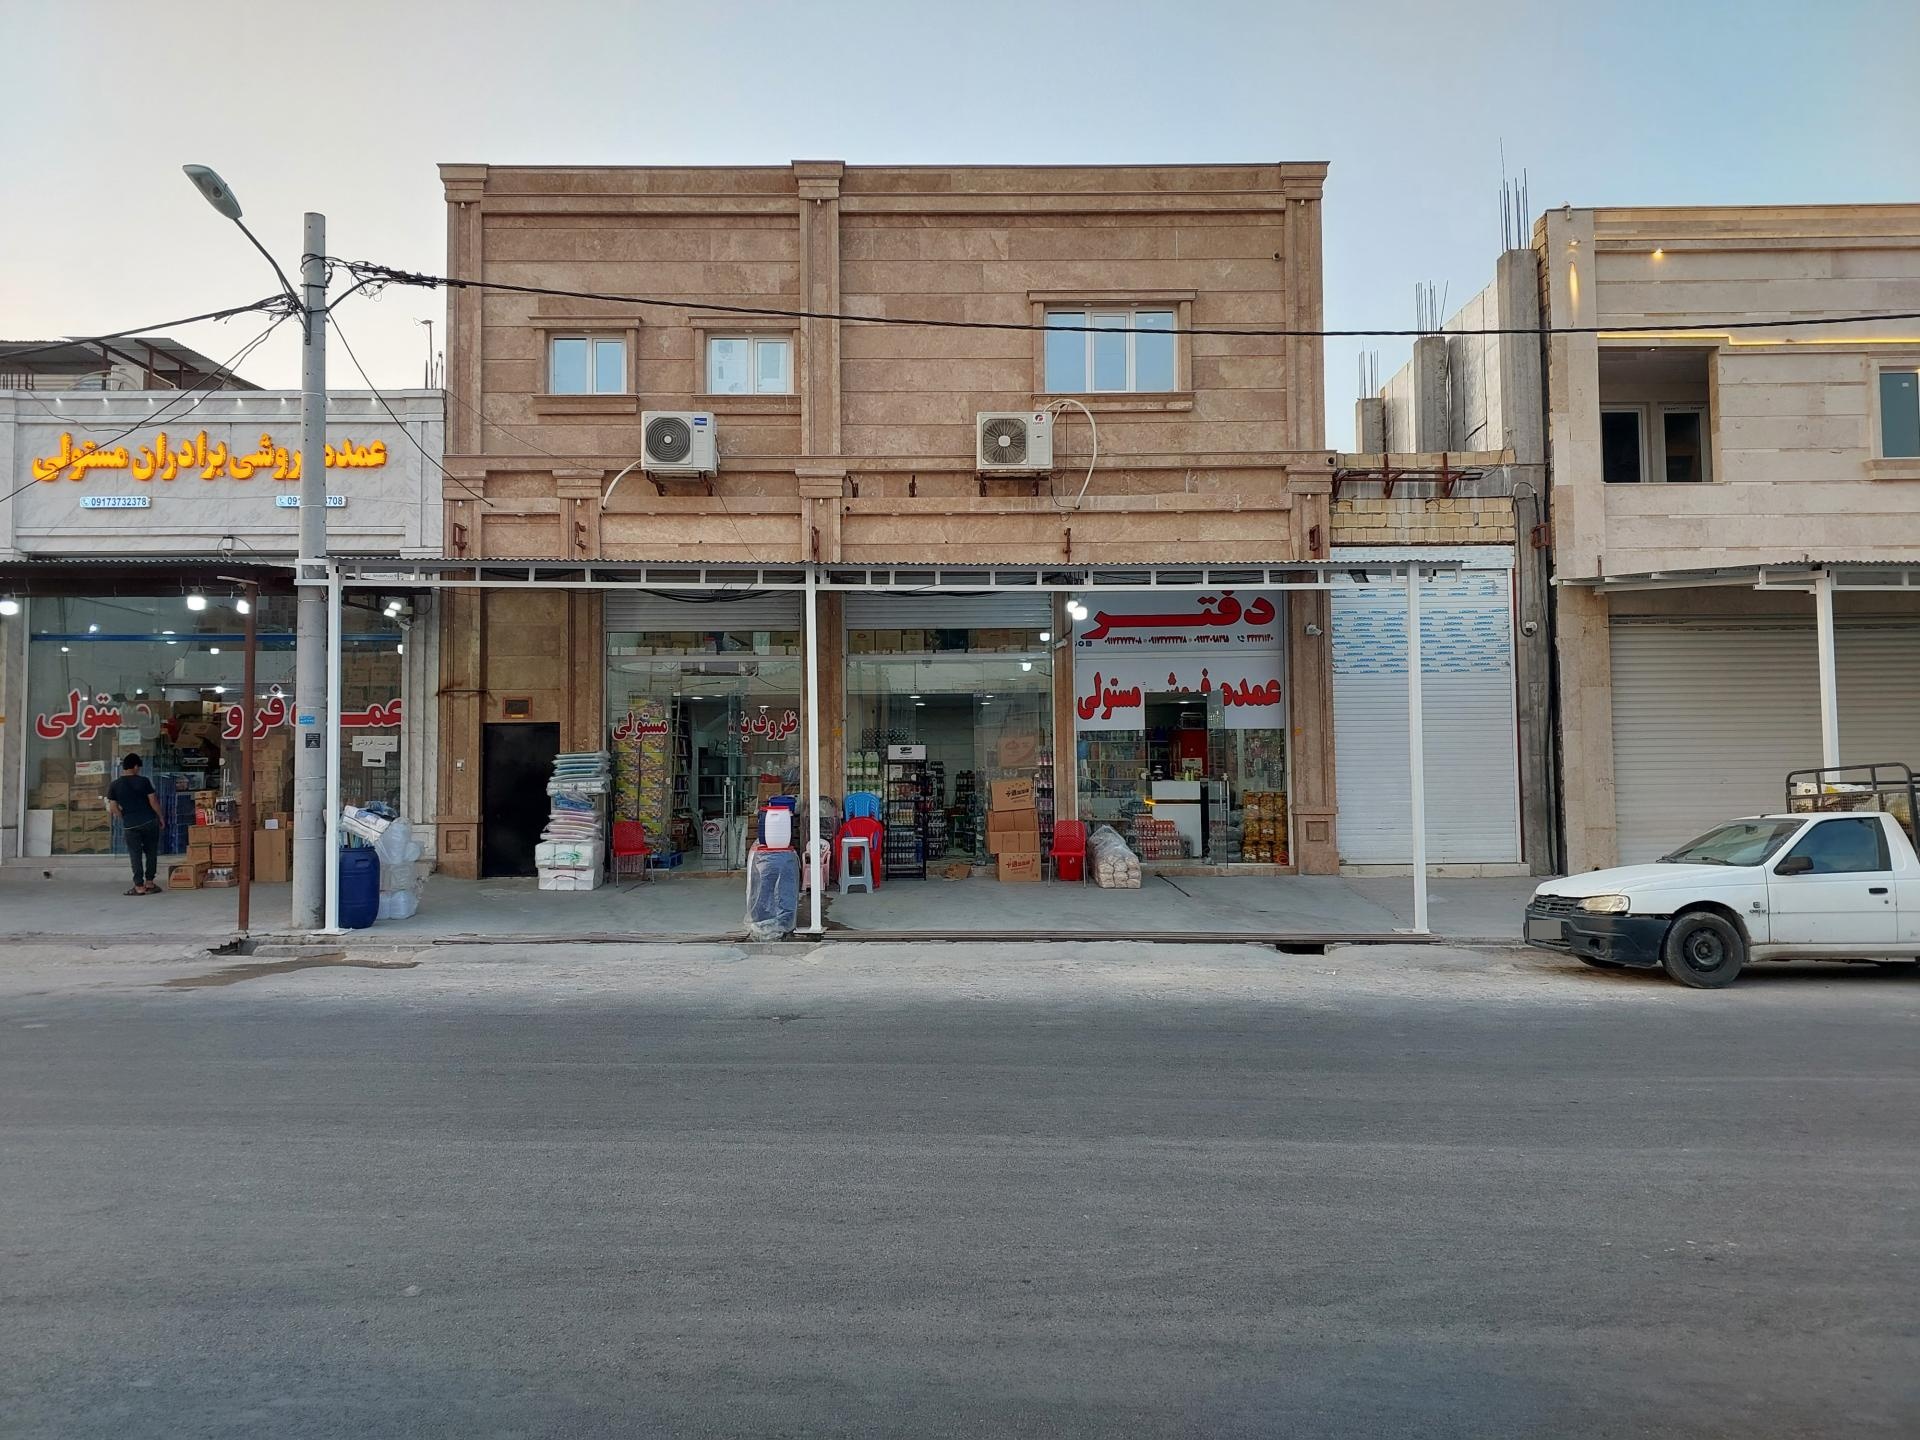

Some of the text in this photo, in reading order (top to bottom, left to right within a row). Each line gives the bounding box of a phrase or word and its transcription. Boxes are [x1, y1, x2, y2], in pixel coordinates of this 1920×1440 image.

[31, 431, 130, 482] مستولی
[131, 430, 227, 481] برادران
[228, 431, 303, 480] روشی
[91, 497, 147, 507] 09173732378
[1080, 590, 1276, 640] دفتر
[1078, 671, 1142, 720] مستولی
[1220, 678, 1282, 707] عمده
[612, 711, 669, 742] مستولی
[751, 705, 799, 742] ظروف
